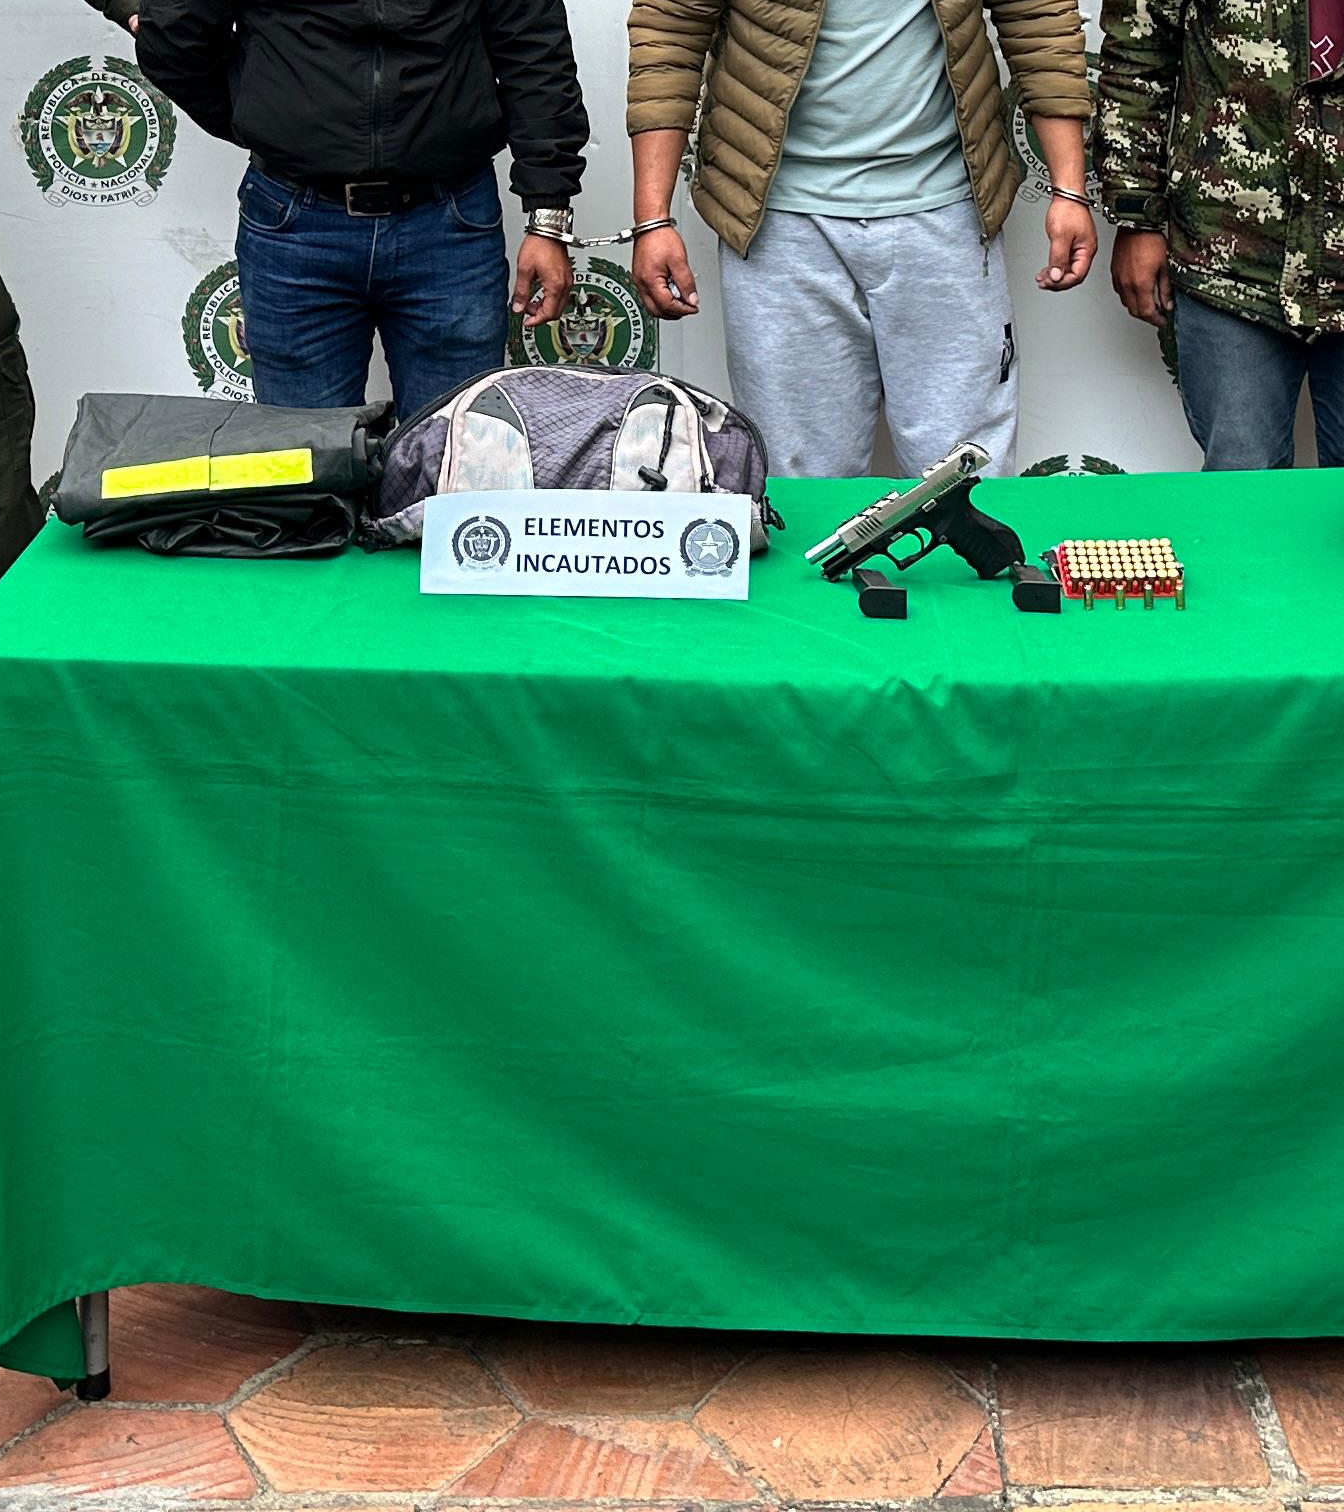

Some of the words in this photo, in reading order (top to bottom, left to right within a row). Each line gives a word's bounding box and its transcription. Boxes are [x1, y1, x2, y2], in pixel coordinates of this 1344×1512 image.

[91, 73, 109, 81] DE
[120, 79, 158, 140] COLOMBIA
[100, 154, 153, 190] NACIONAL
[60, 185, 90, 202] DIOS
[90, 193, 98, 203] Y
[100, 186, 141, 203] PATRIA
[575, 273, 592, 282] DE
[604, 280, 642, 341] COLOMBIA
[524, 517, 665, 539] ELEMENTOS
[516, 553, 671, 576] INCAUTADOS
